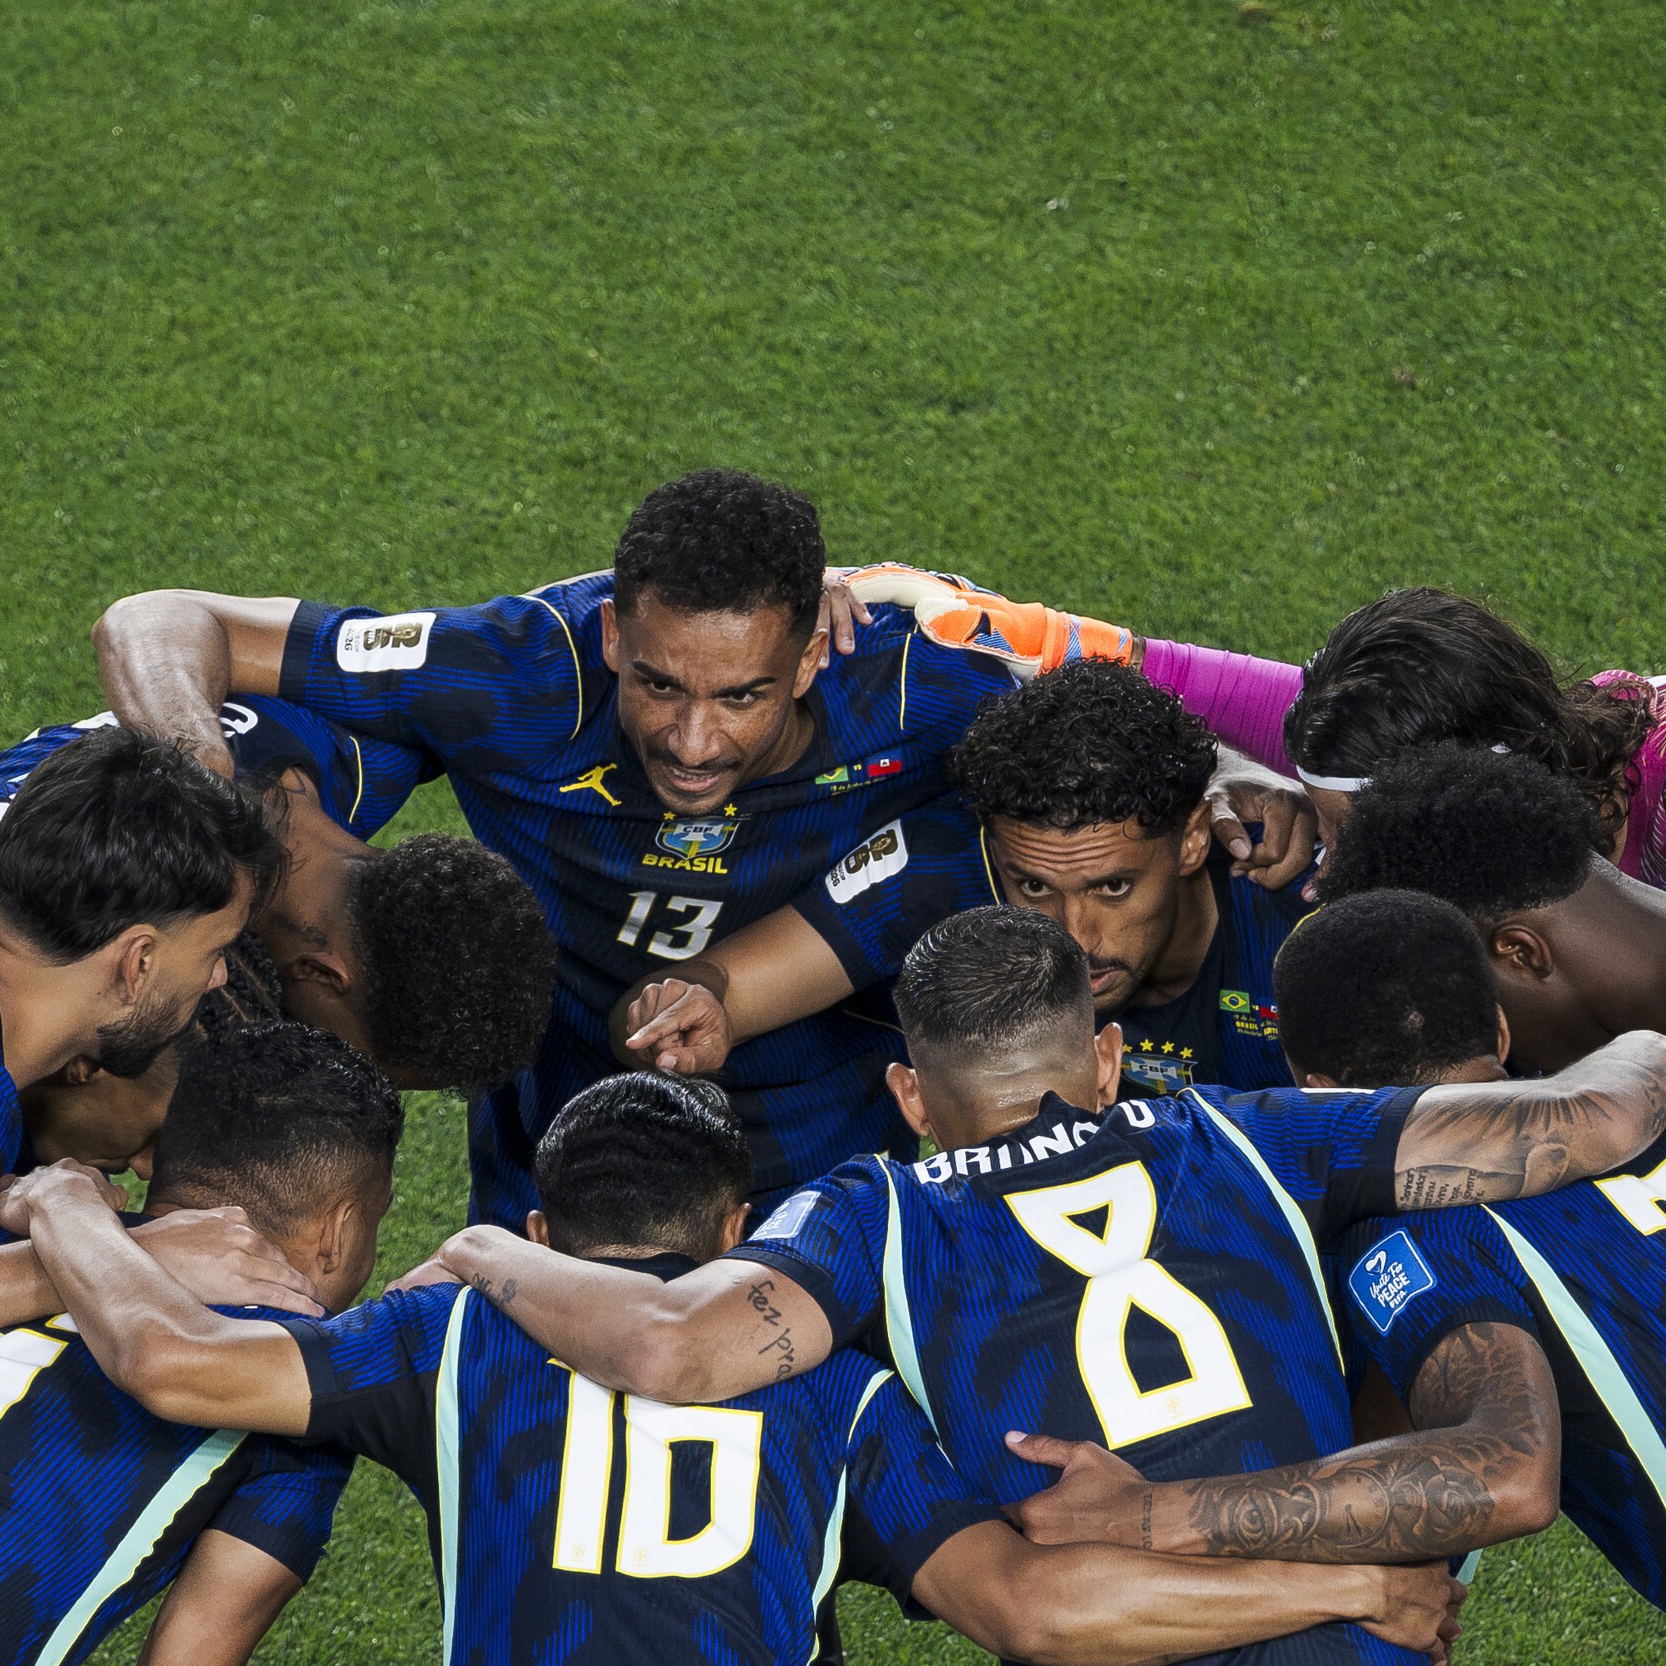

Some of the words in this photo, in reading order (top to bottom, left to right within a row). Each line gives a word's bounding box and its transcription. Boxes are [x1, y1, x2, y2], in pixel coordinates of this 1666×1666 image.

[683, 825, 714, 833] CBF
[642, 853, 728, 874] BRASIL
[616, 890, 724, 961] 13
[1138, 1064, 1169, 1074] CBF
[1377, 1272, 1411, 1308] PEACE
[1003, 1160, 1253, 1451] 8
